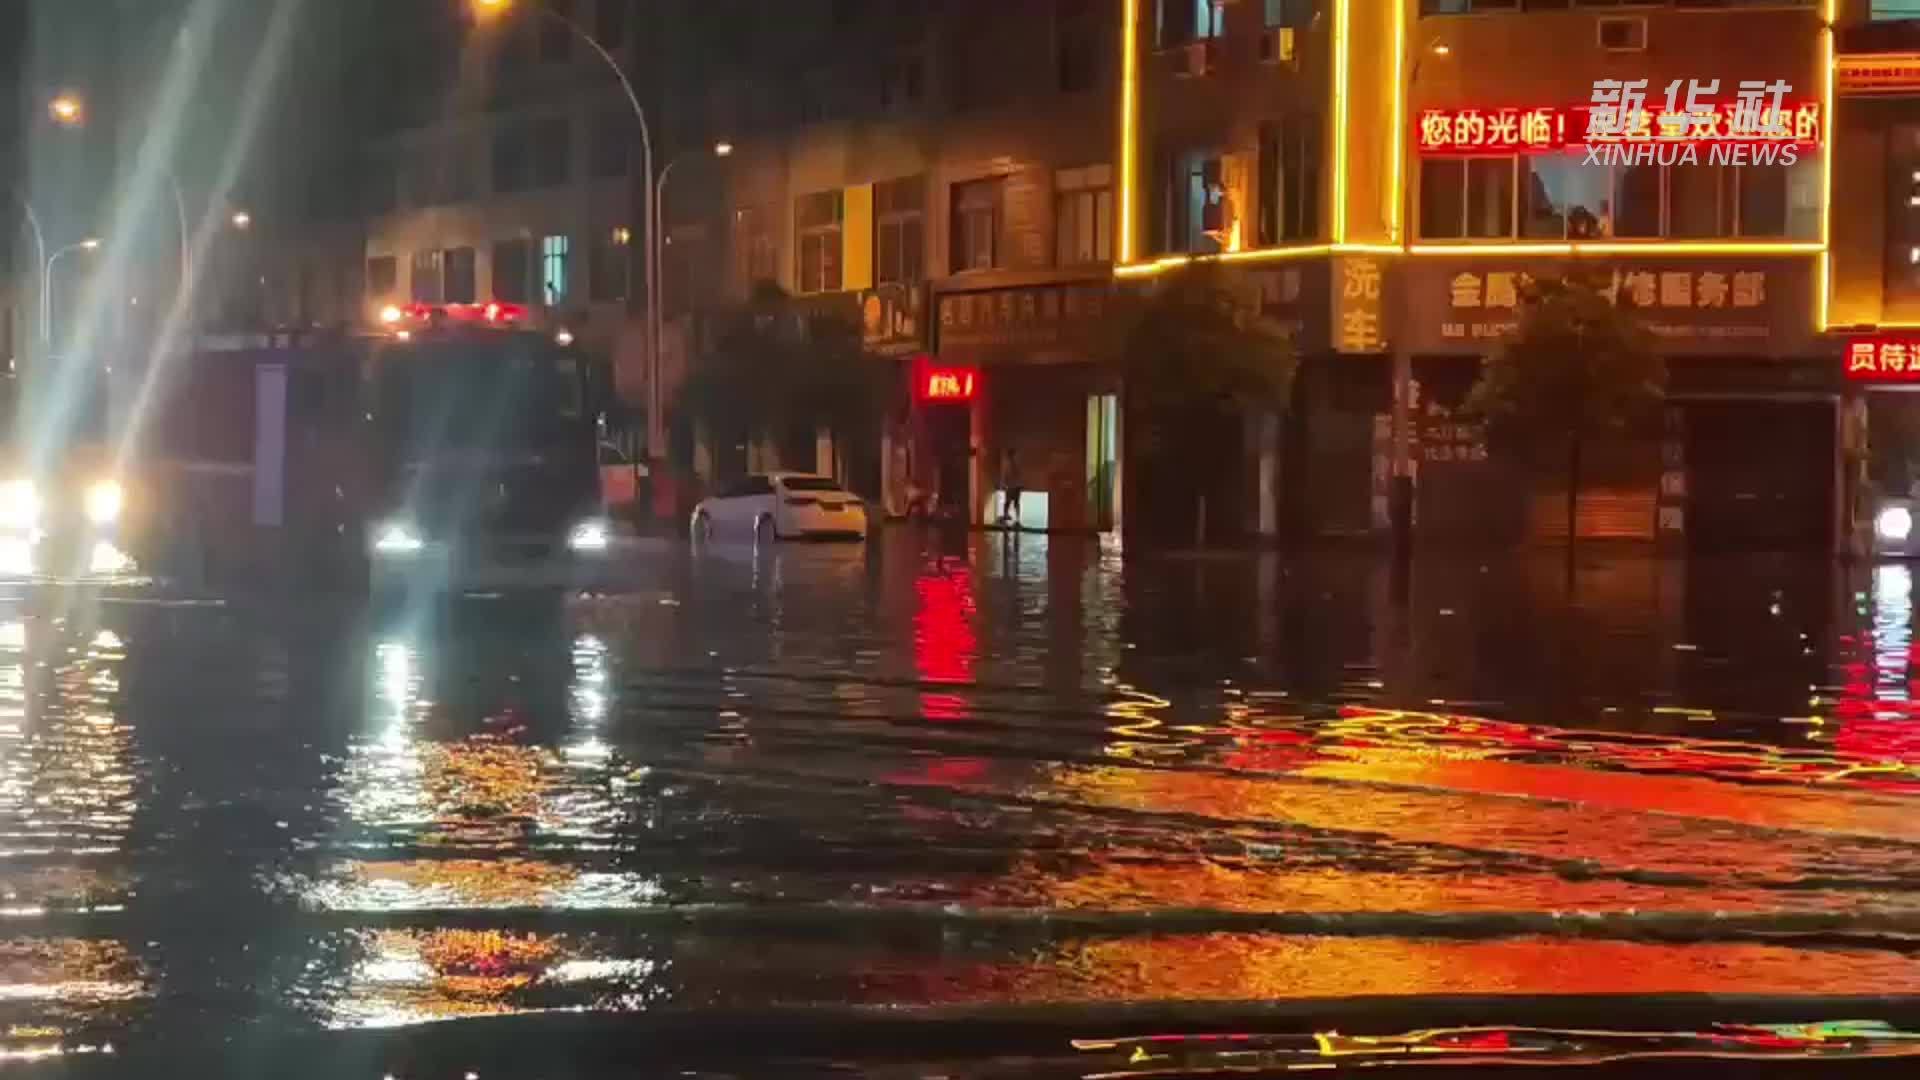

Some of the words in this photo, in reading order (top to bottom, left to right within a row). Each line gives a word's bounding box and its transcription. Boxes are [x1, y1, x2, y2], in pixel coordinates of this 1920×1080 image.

[1343, 257, 1381, 350] 洗车
[1450, 270, 1766, 308] 金属修服务部
